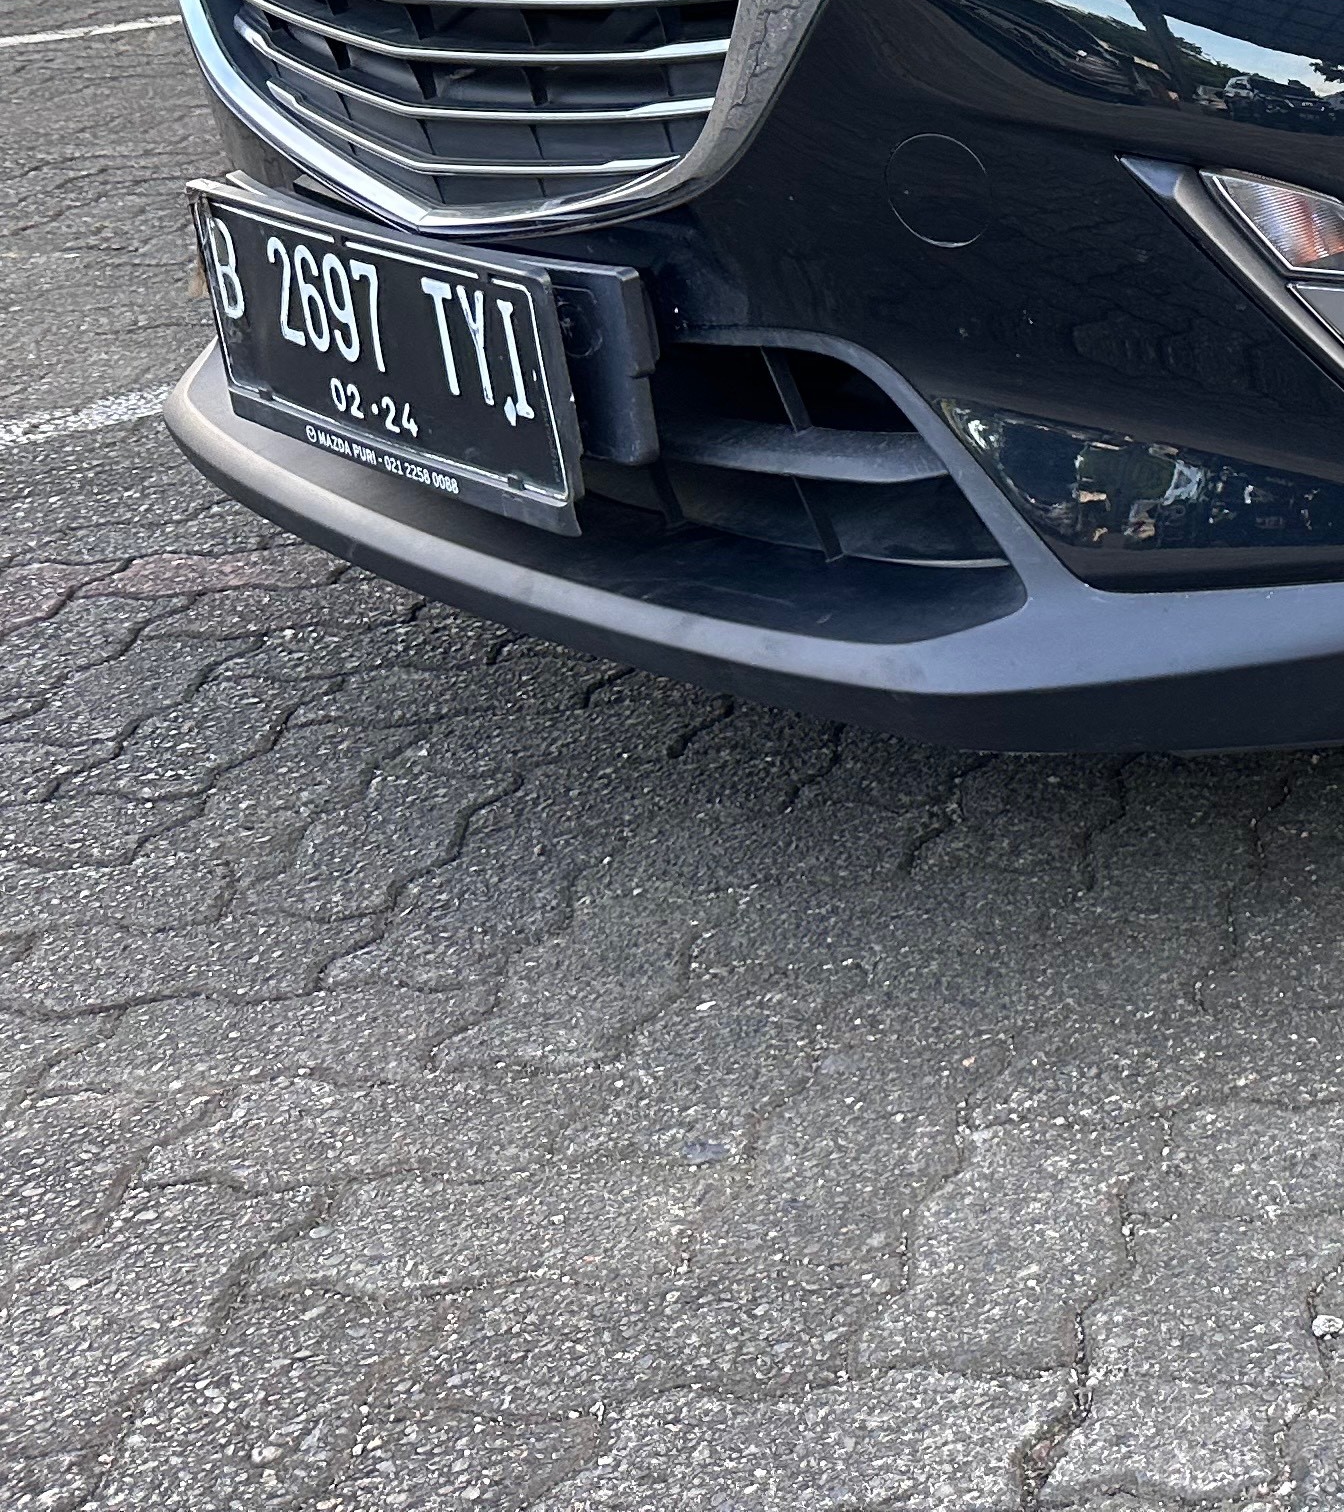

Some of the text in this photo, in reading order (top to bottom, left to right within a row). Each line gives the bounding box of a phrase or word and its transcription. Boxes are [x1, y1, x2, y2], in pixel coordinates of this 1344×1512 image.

[207, 217, 245, 320] B
[267, 236, 386, 373] 2697
[317, 429, 352, 457] MAZDA
[352, 442, 377, 466] PURI
[384, 455, 404, 476] 021
[404, 462, 431, 485] 2258
[431, 471, 460, 494] 0088
